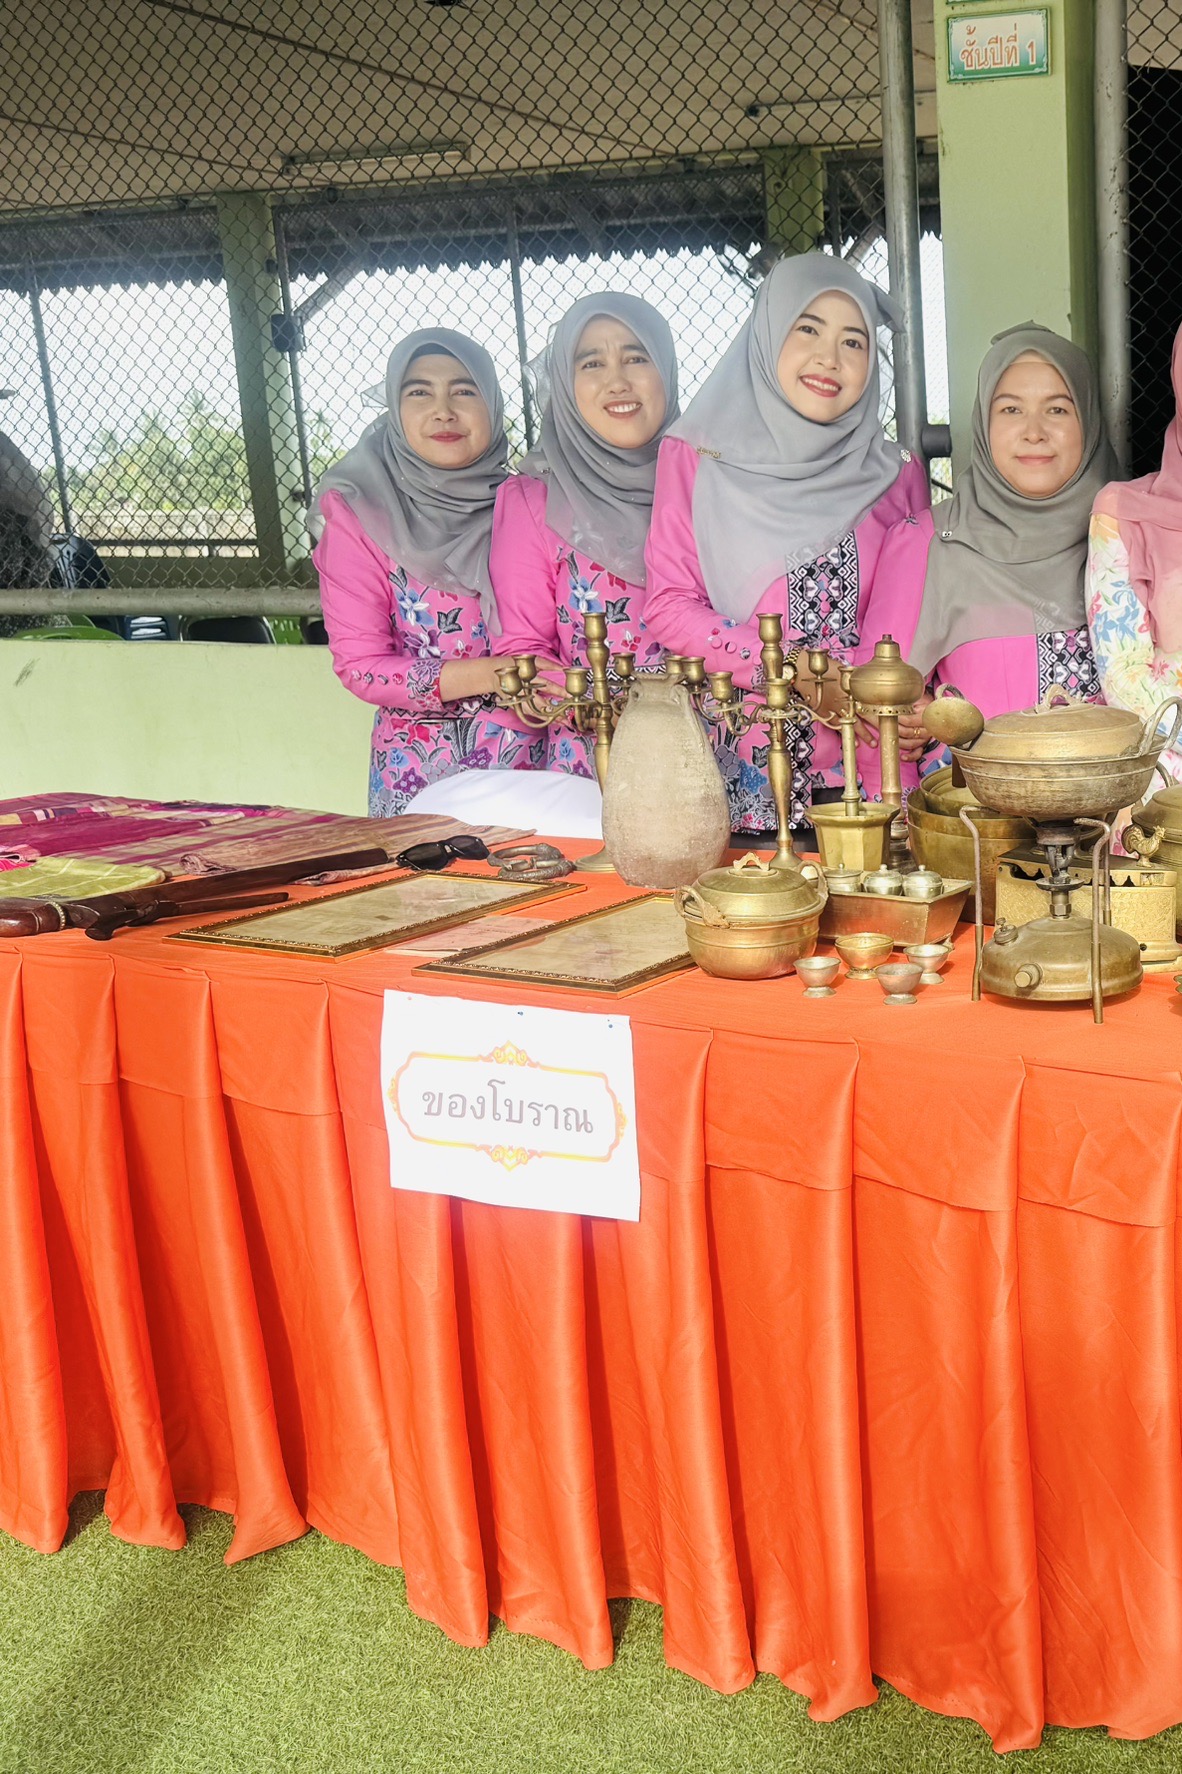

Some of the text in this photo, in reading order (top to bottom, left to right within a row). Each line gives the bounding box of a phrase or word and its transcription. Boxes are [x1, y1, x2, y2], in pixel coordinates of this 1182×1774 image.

[961, 23, 1036, 69] ชั้นปีที่ 1
[422, 1078, 594, 1134] ของโบราณ
